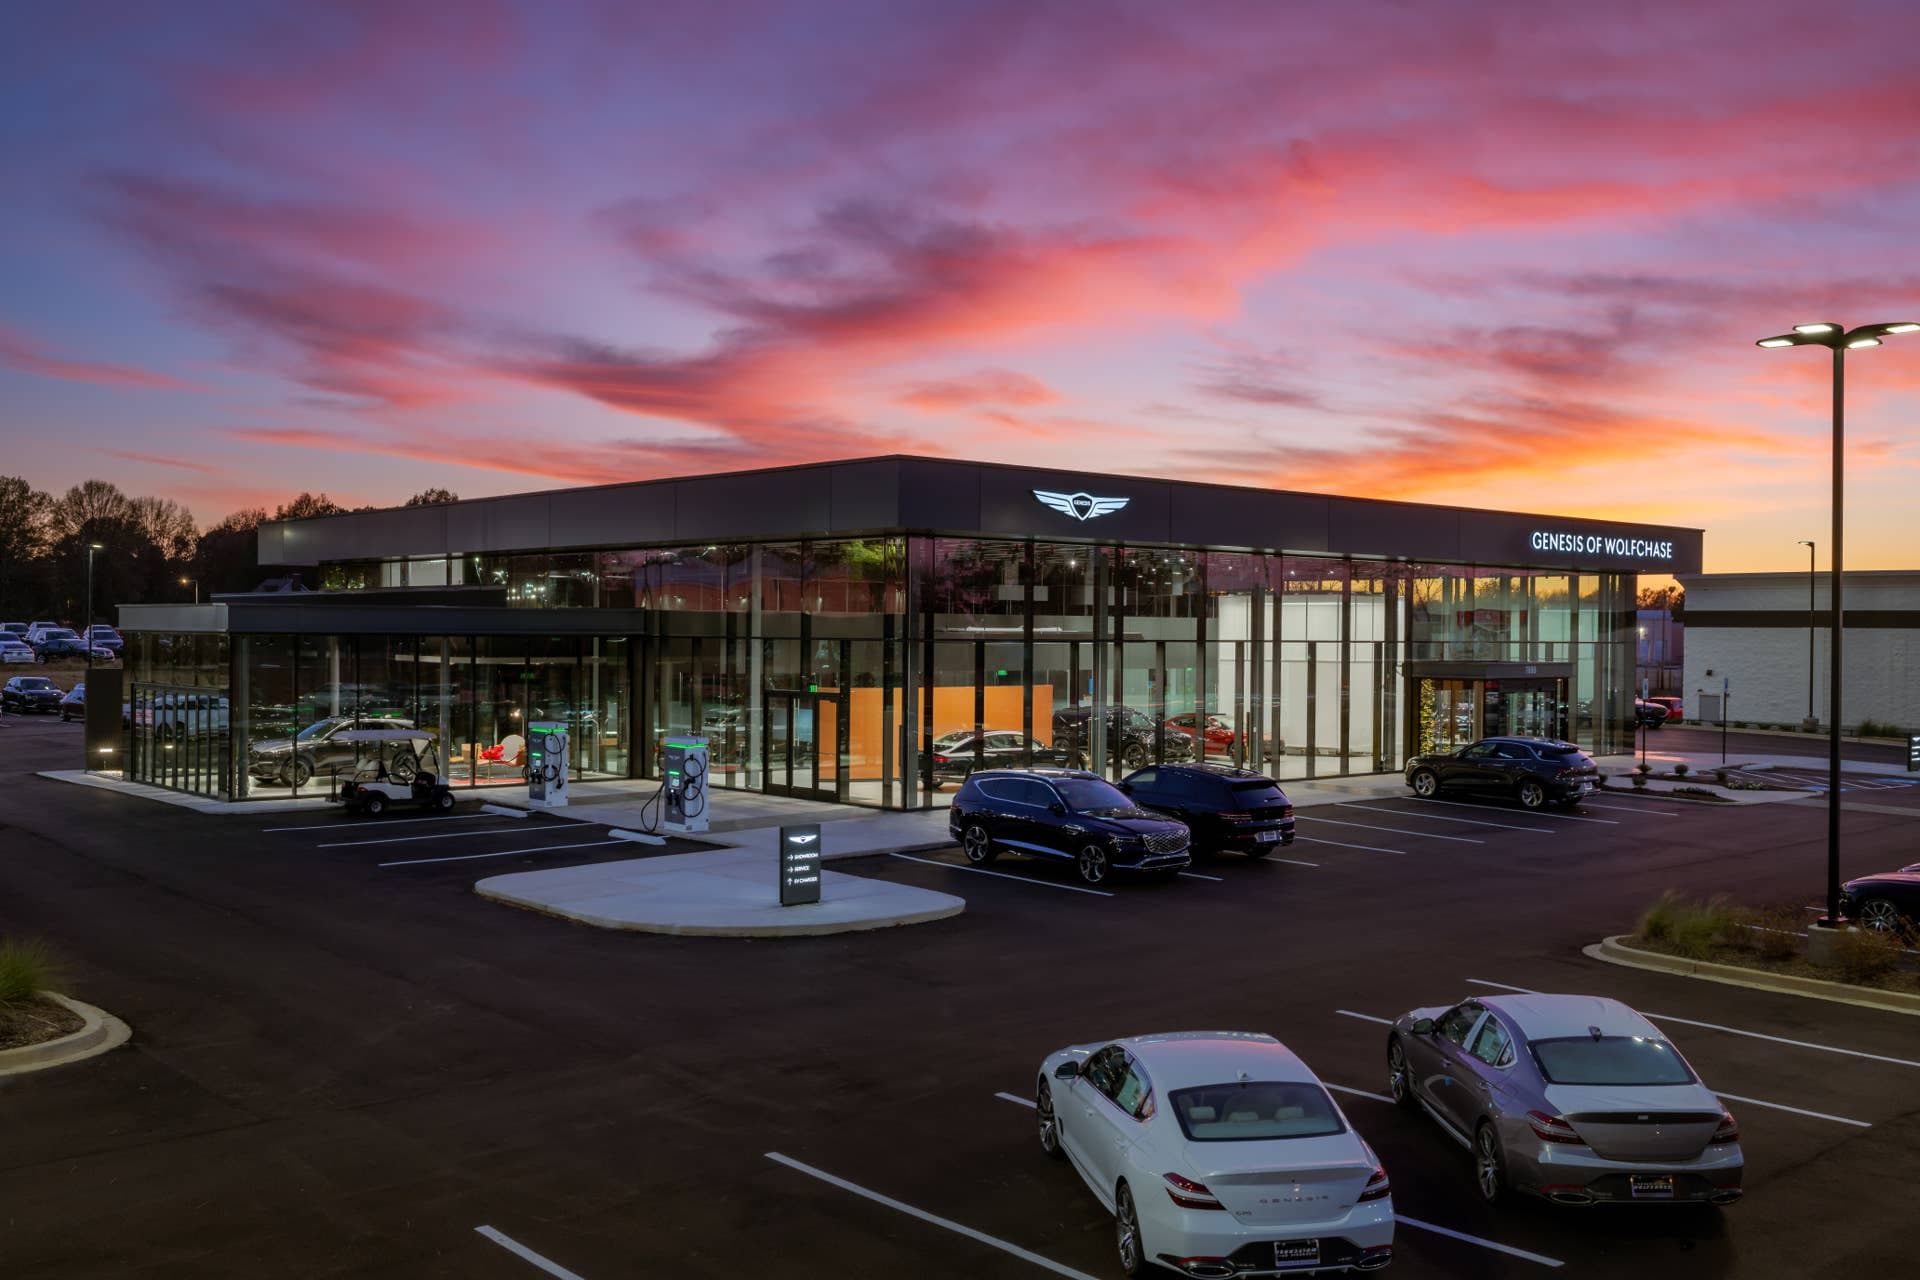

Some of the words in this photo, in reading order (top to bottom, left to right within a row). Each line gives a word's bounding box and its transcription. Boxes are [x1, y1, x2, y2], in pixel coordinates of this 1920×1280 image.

[1532, 531, 1584, 554] GENESIS
[1586, 536, 1602, 554] OF
[1604, 538, 1673, 559] WOLFCHASE
[794, 852, 819, 860] SHOWROOM
[800, 876, 818, 884] CHARGER
[1259, 1195, 1329, 1204] GENESIS
